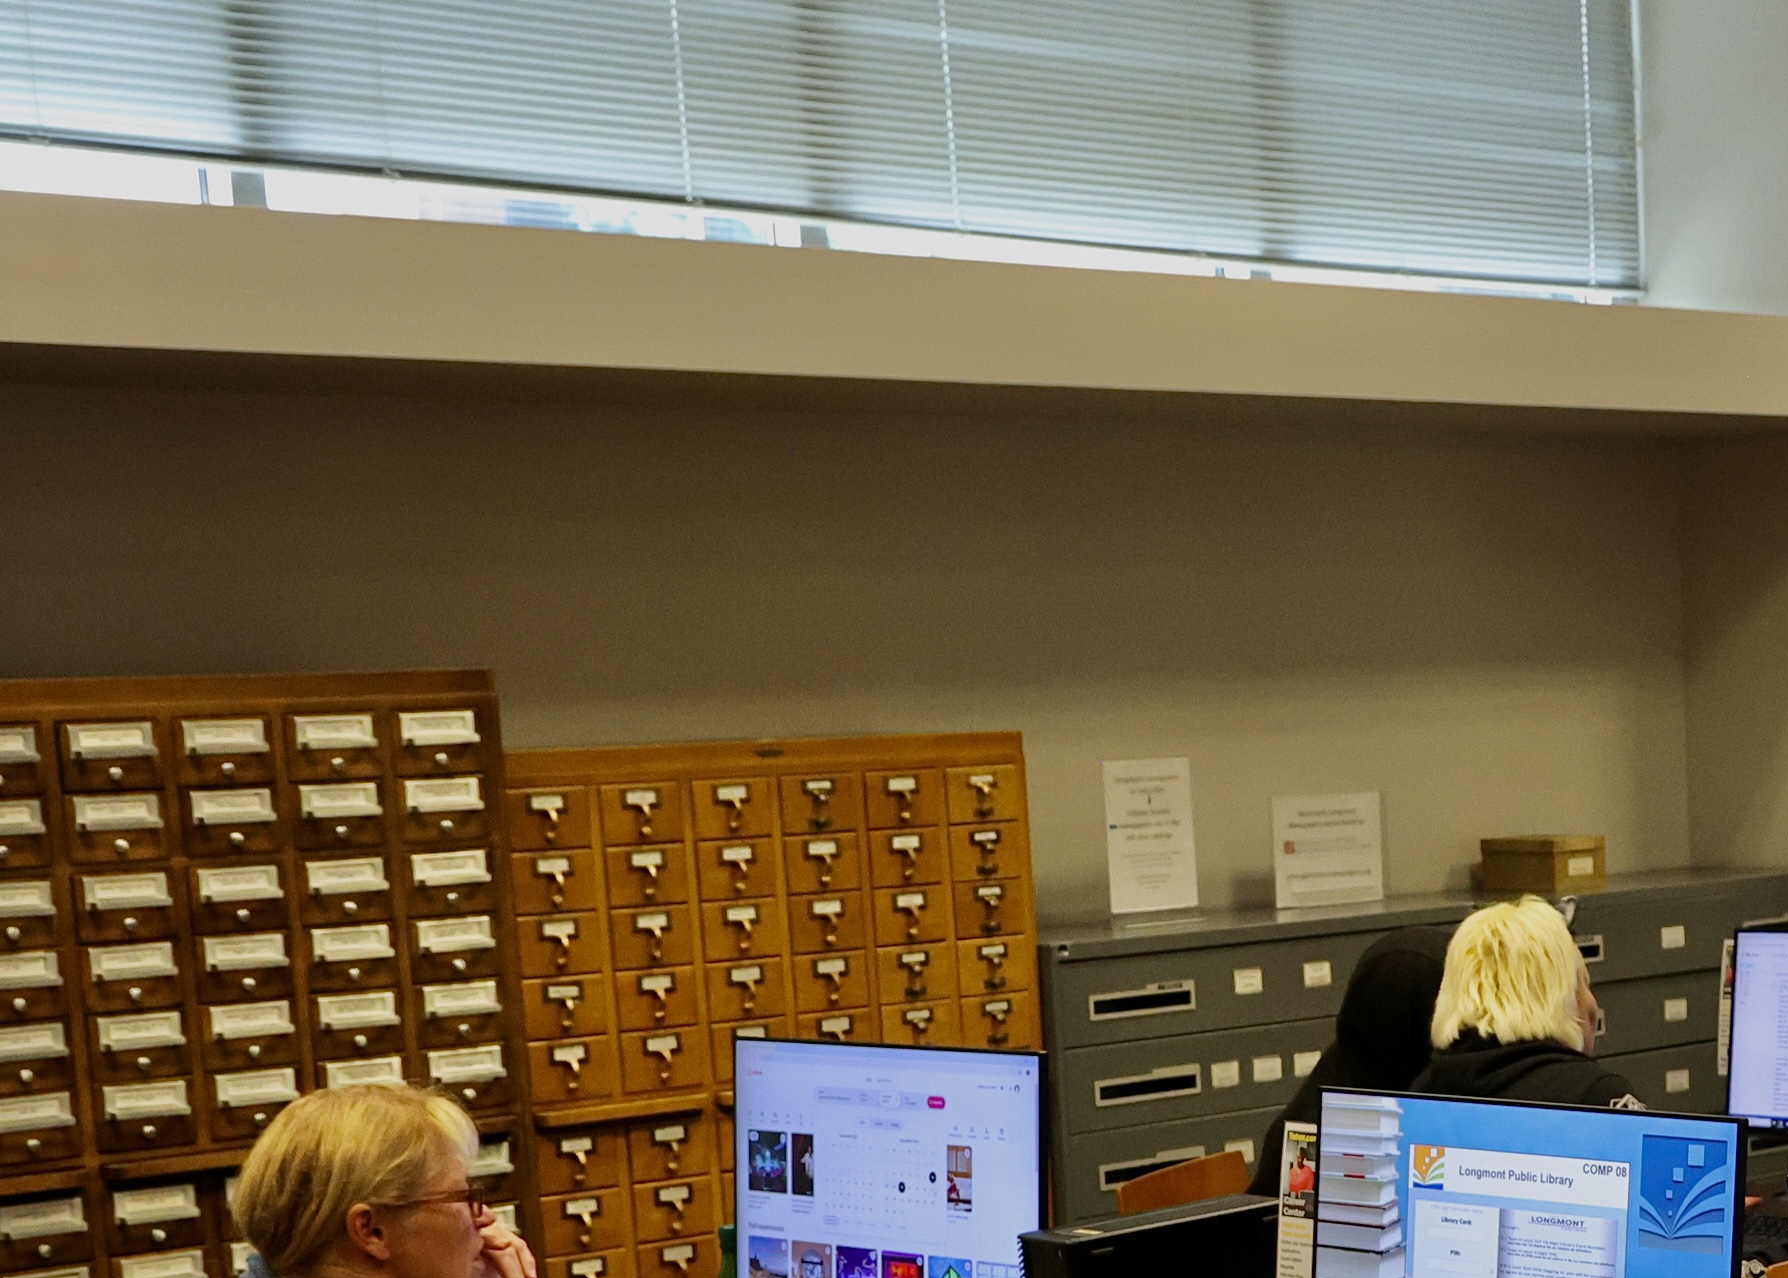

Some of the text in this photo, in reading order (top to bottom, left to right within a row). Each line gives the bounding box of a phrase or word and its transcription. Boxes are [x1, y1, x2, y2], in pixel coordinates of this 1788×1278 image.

[1583, 1163, 1627, 1178] COMP 08
[1459, 1165, 1574, 1188] Longmont Public Library
[1283, 1207, 1306, 1218] Center
[1441, 1216, 1472, 1226] Library Card:
[1531, 1216, 1585, 1227] LONGMONT
